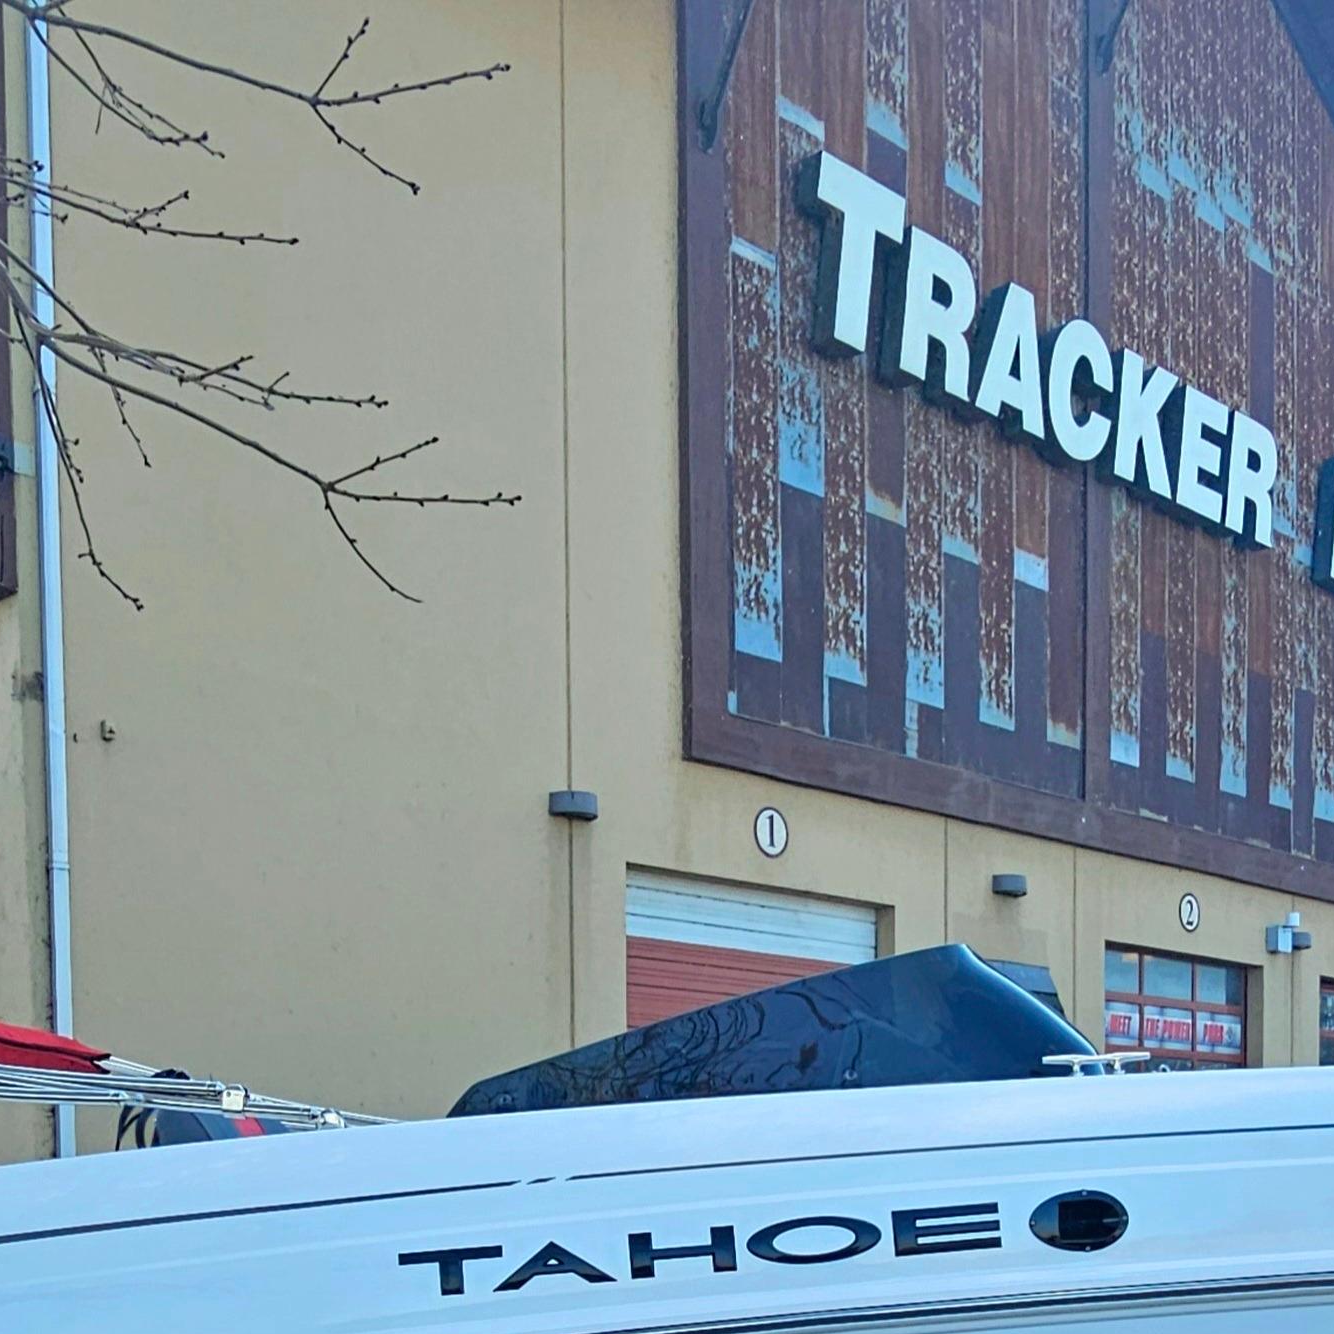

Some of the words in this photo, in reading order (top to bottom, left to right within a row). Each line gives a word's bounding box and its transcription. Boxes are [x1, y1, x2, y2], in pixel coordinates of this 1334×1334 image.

[813, 150, 1279, 550] TRACKER
[1185, 899, 1194, 926] 2
[398, 1201, 1003, 1296] TAHOE
